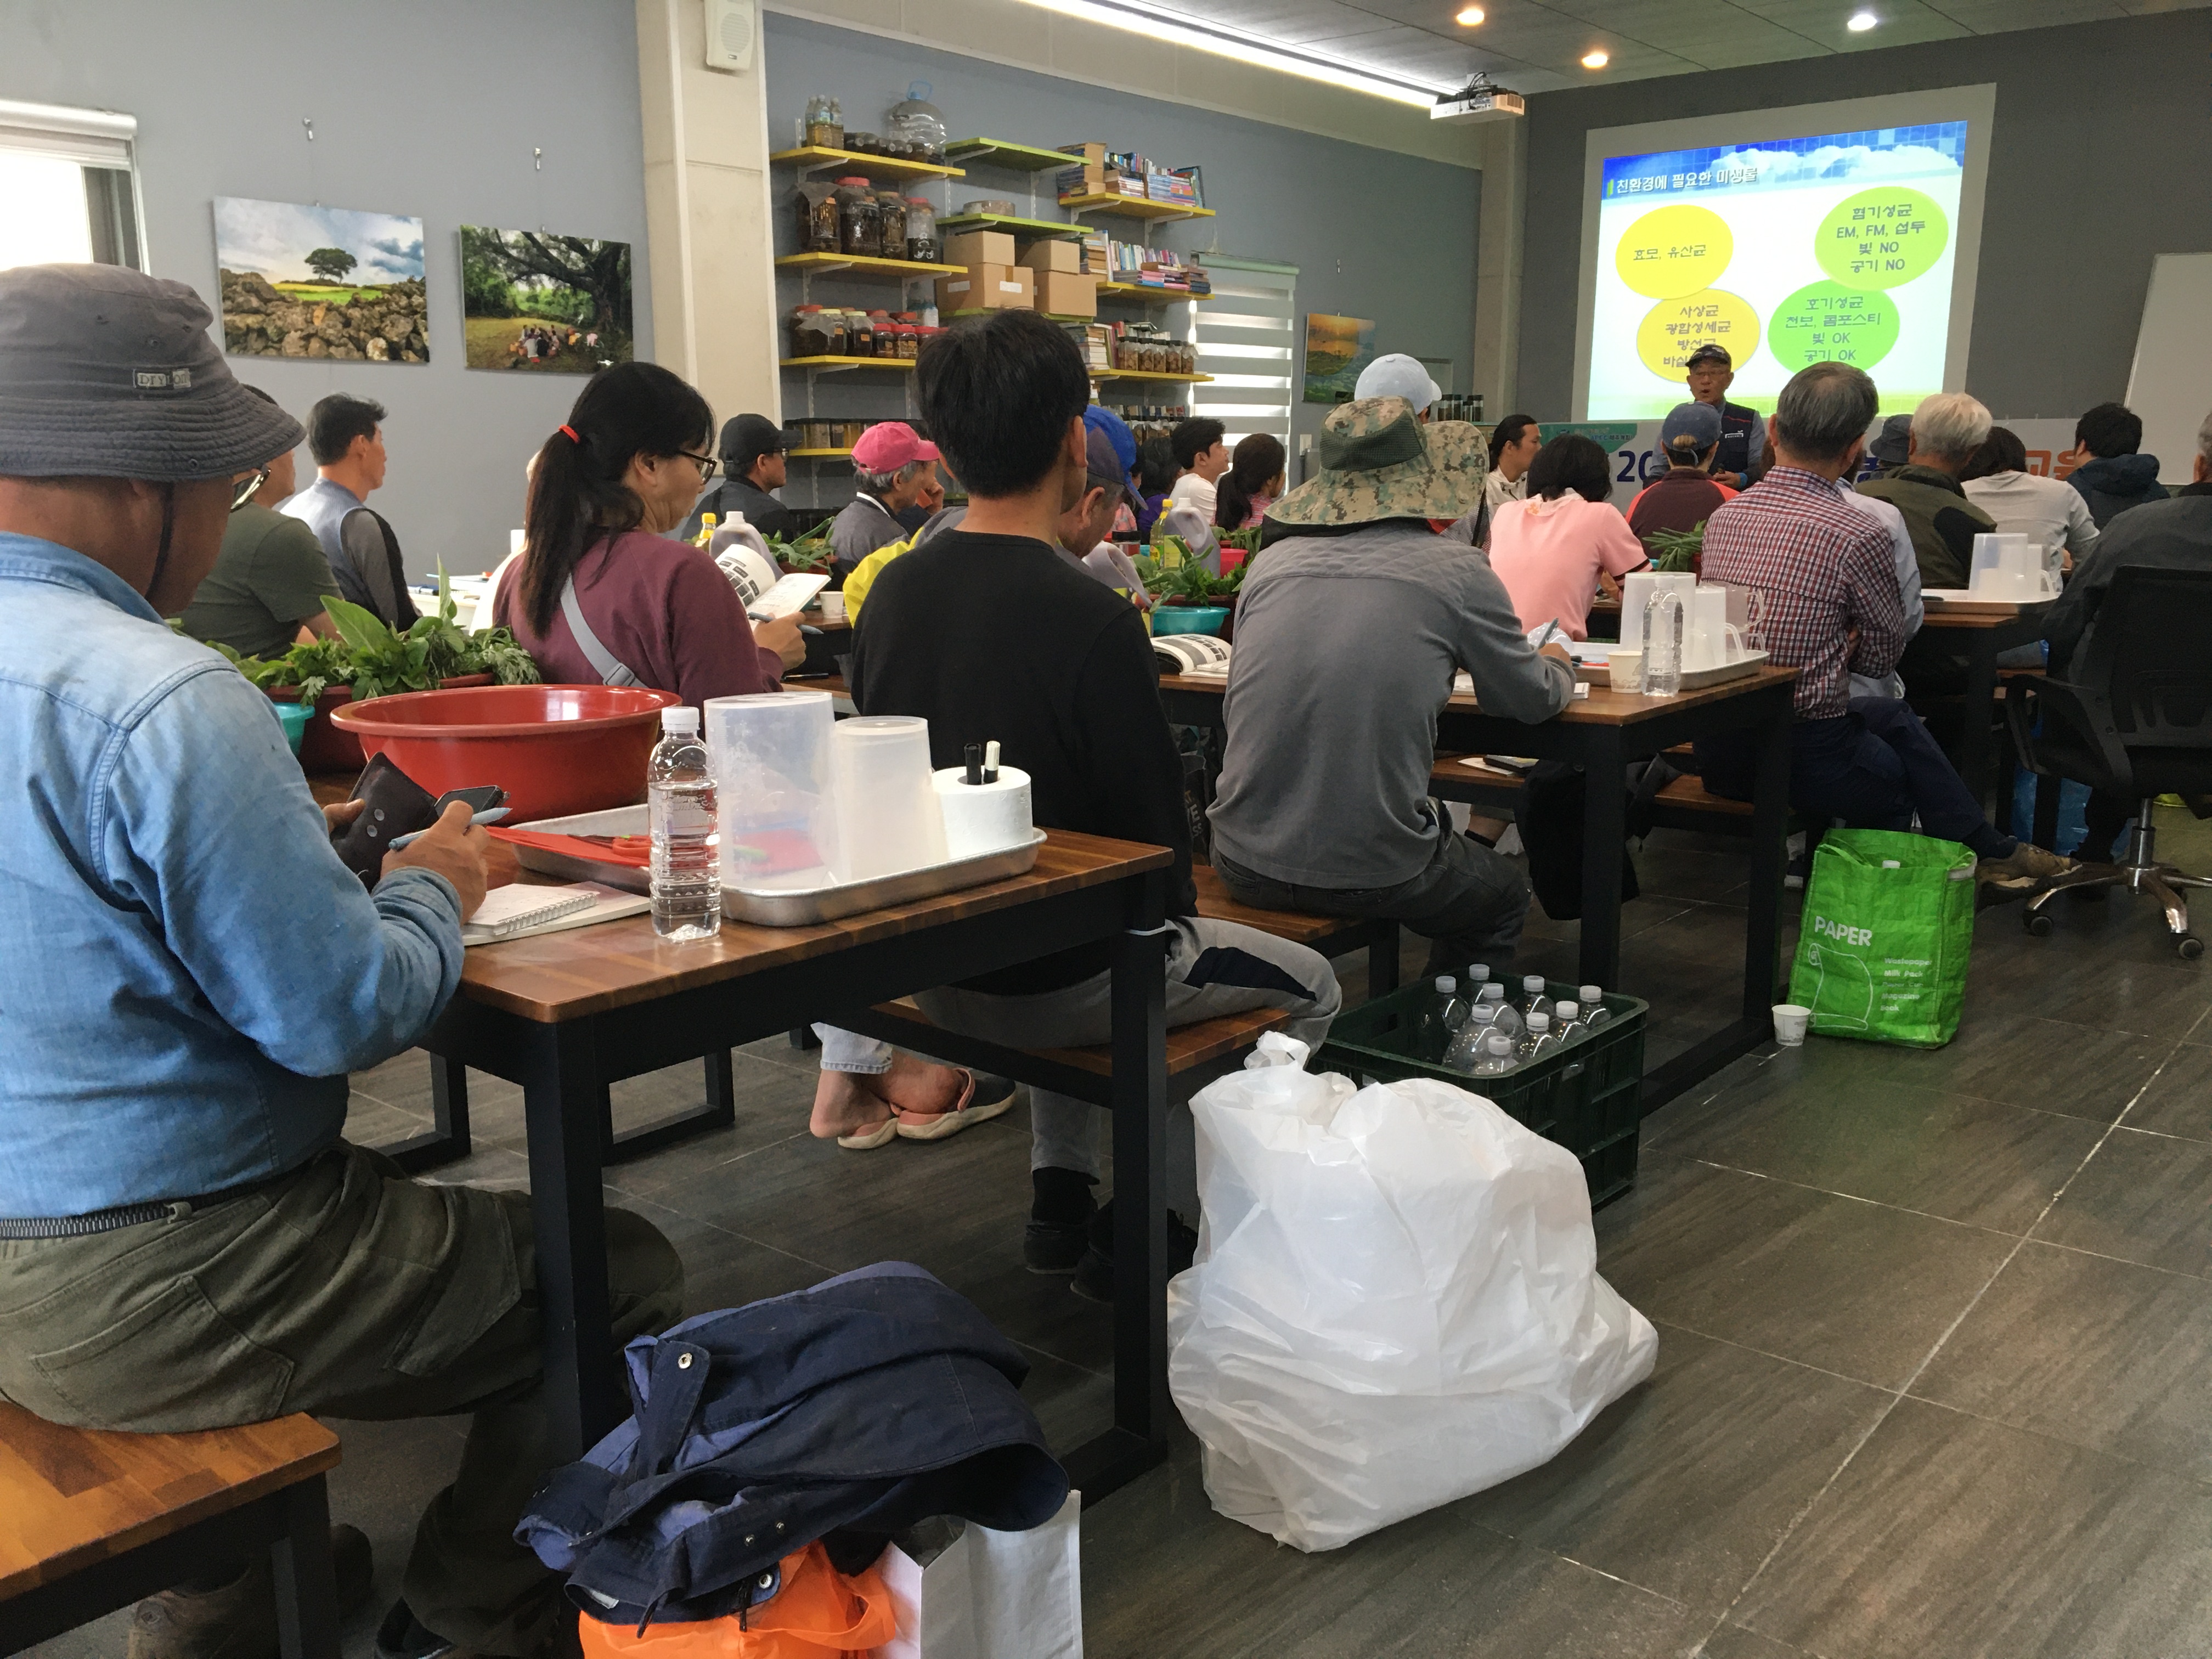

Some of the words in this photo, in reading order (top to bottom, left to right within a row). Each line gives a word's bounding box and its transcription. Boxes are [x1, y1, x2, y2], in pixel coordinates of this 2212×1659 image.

[1617, 174, 1668, 194] 친환경에
[1672, 171, 1712, 189] 필요한
[1717, 168, 1758, 184] 미생물
[1852, 204, 1912, 221] 혐기성균
[1836, 225, 1859, 239] EM,
[1866, 224, 1888, 237] FM,
[1633, 248, 1662, 261] 효모,
[1667, 244, 1707, 259] 유산균
[1859, 242, 1873, 256] 빛
[1880, 241, 1899, 253] NO
[1850, 259, 1878, 273] 공기
[1885, 258, 1905, 271] NO
[1679, 304, 1719, 318] 사상균
[1805, 296, 1864, 311] 호기성균
[1665, 320, 1731, 335] 광합성세균
[1785, 315, 1816, 329] 천보,
[1813, 332, 1825, 345] 빛
[1832, 332, 1851, 344] OK
[1804, 349, 1831, 362] 공기
[1838, 349, 1857, 361] OK
[1814, 916, 1872, 946] PAPER
